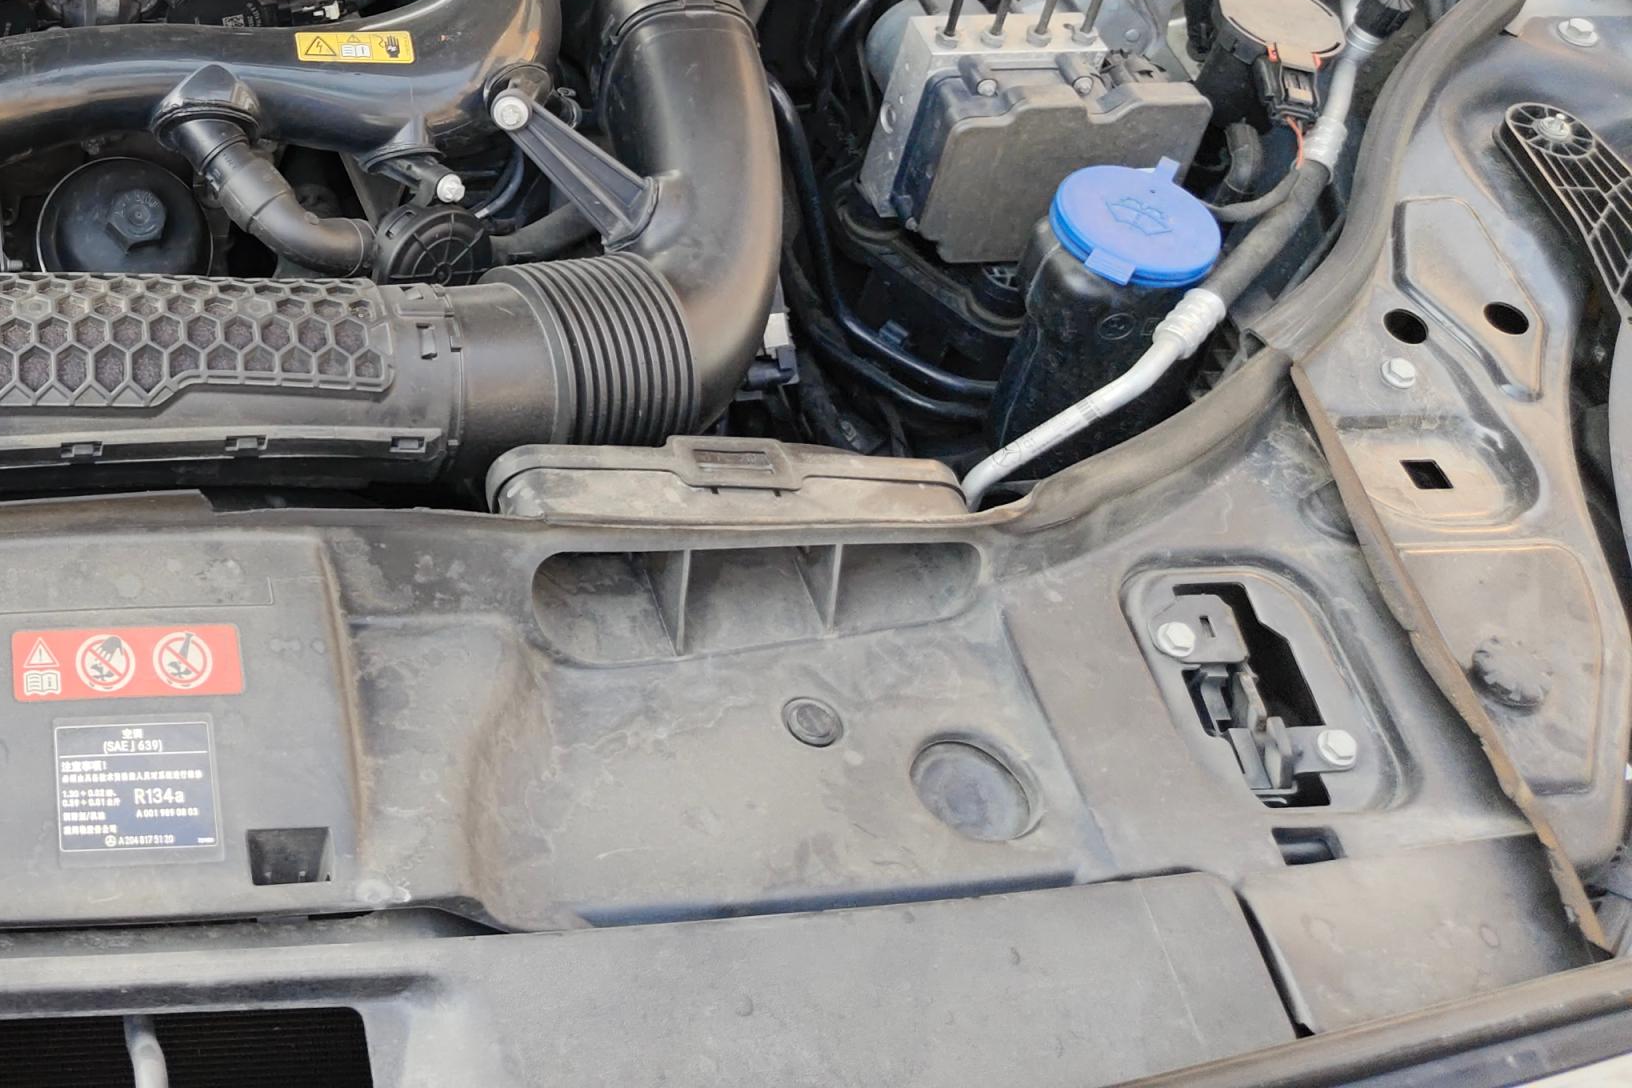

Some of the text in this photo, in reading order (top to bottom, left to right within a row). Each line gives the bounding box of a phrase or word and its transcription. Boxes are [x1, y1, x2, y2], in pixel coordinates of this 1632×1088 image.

[103, 740, 129, 754] (SAE
[137, 739, 163, 753] 639)
[134, 787, 185, 805] R134a
